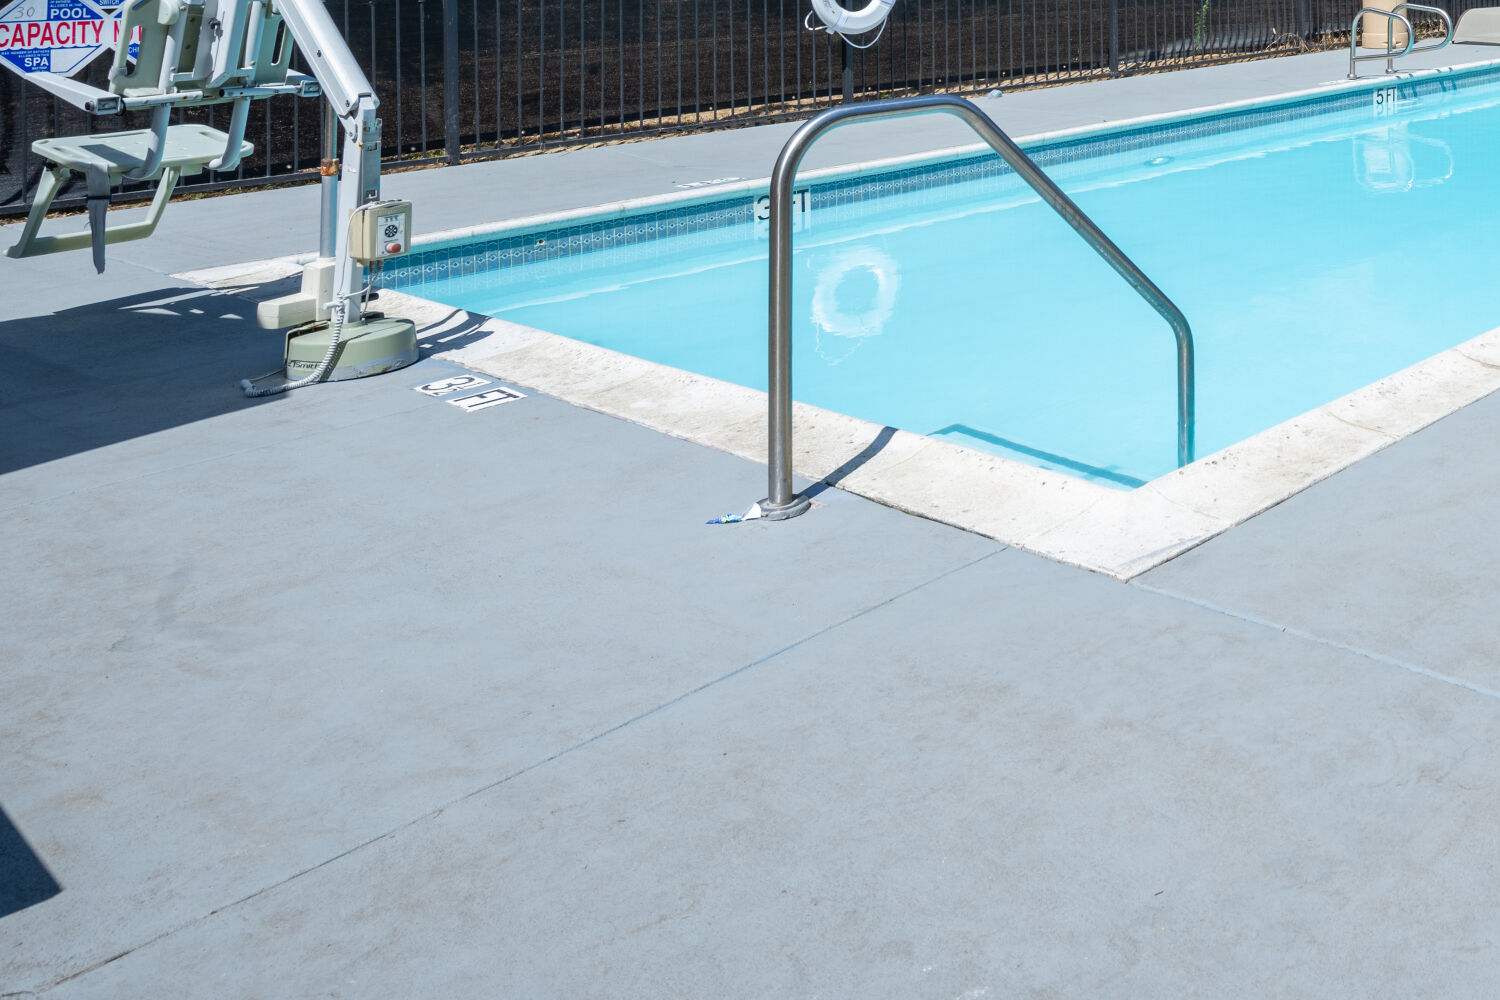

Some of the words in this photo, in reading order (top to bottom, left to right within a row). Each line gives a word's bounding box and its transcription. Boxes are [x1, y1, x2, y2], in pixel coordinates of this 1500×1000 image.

[14, 6, 36, 19] 30
[50, 8, 91, 19] POOL
[0, 20, 104, 48] CAPACITY
[24, 57, 48, 67] SPA
[1376, 88, 1384, 104] 5
[1387, 87, 1396, 102] FT
[454, 390, 520, 408] FT
